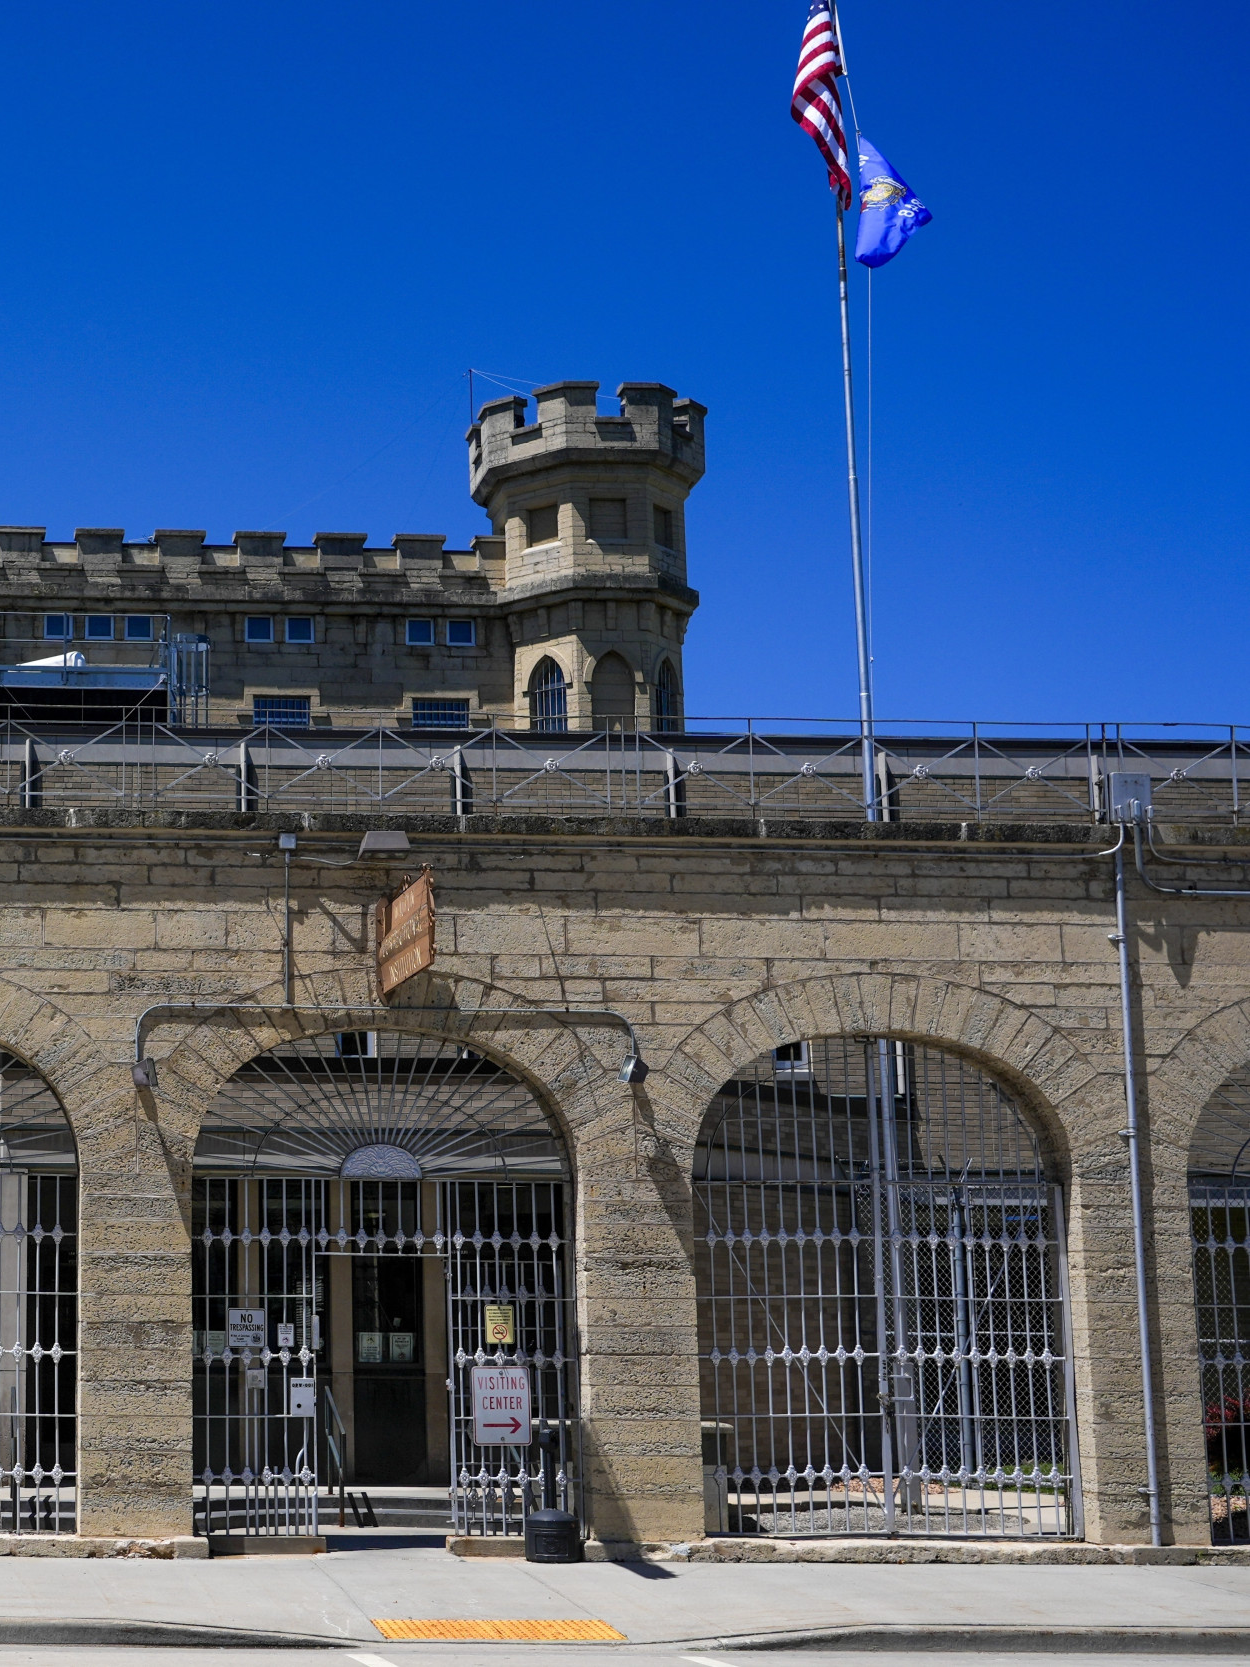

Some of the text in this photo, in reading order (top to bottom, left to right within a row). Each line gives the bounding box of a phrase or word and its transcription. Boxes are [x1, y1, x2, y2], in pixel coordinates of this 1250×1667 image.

[240, 1313, 253, 1323] NO
[477, 1376, 526, 1390] VISITING
[482, 1396, 523, 1410] CENTER
